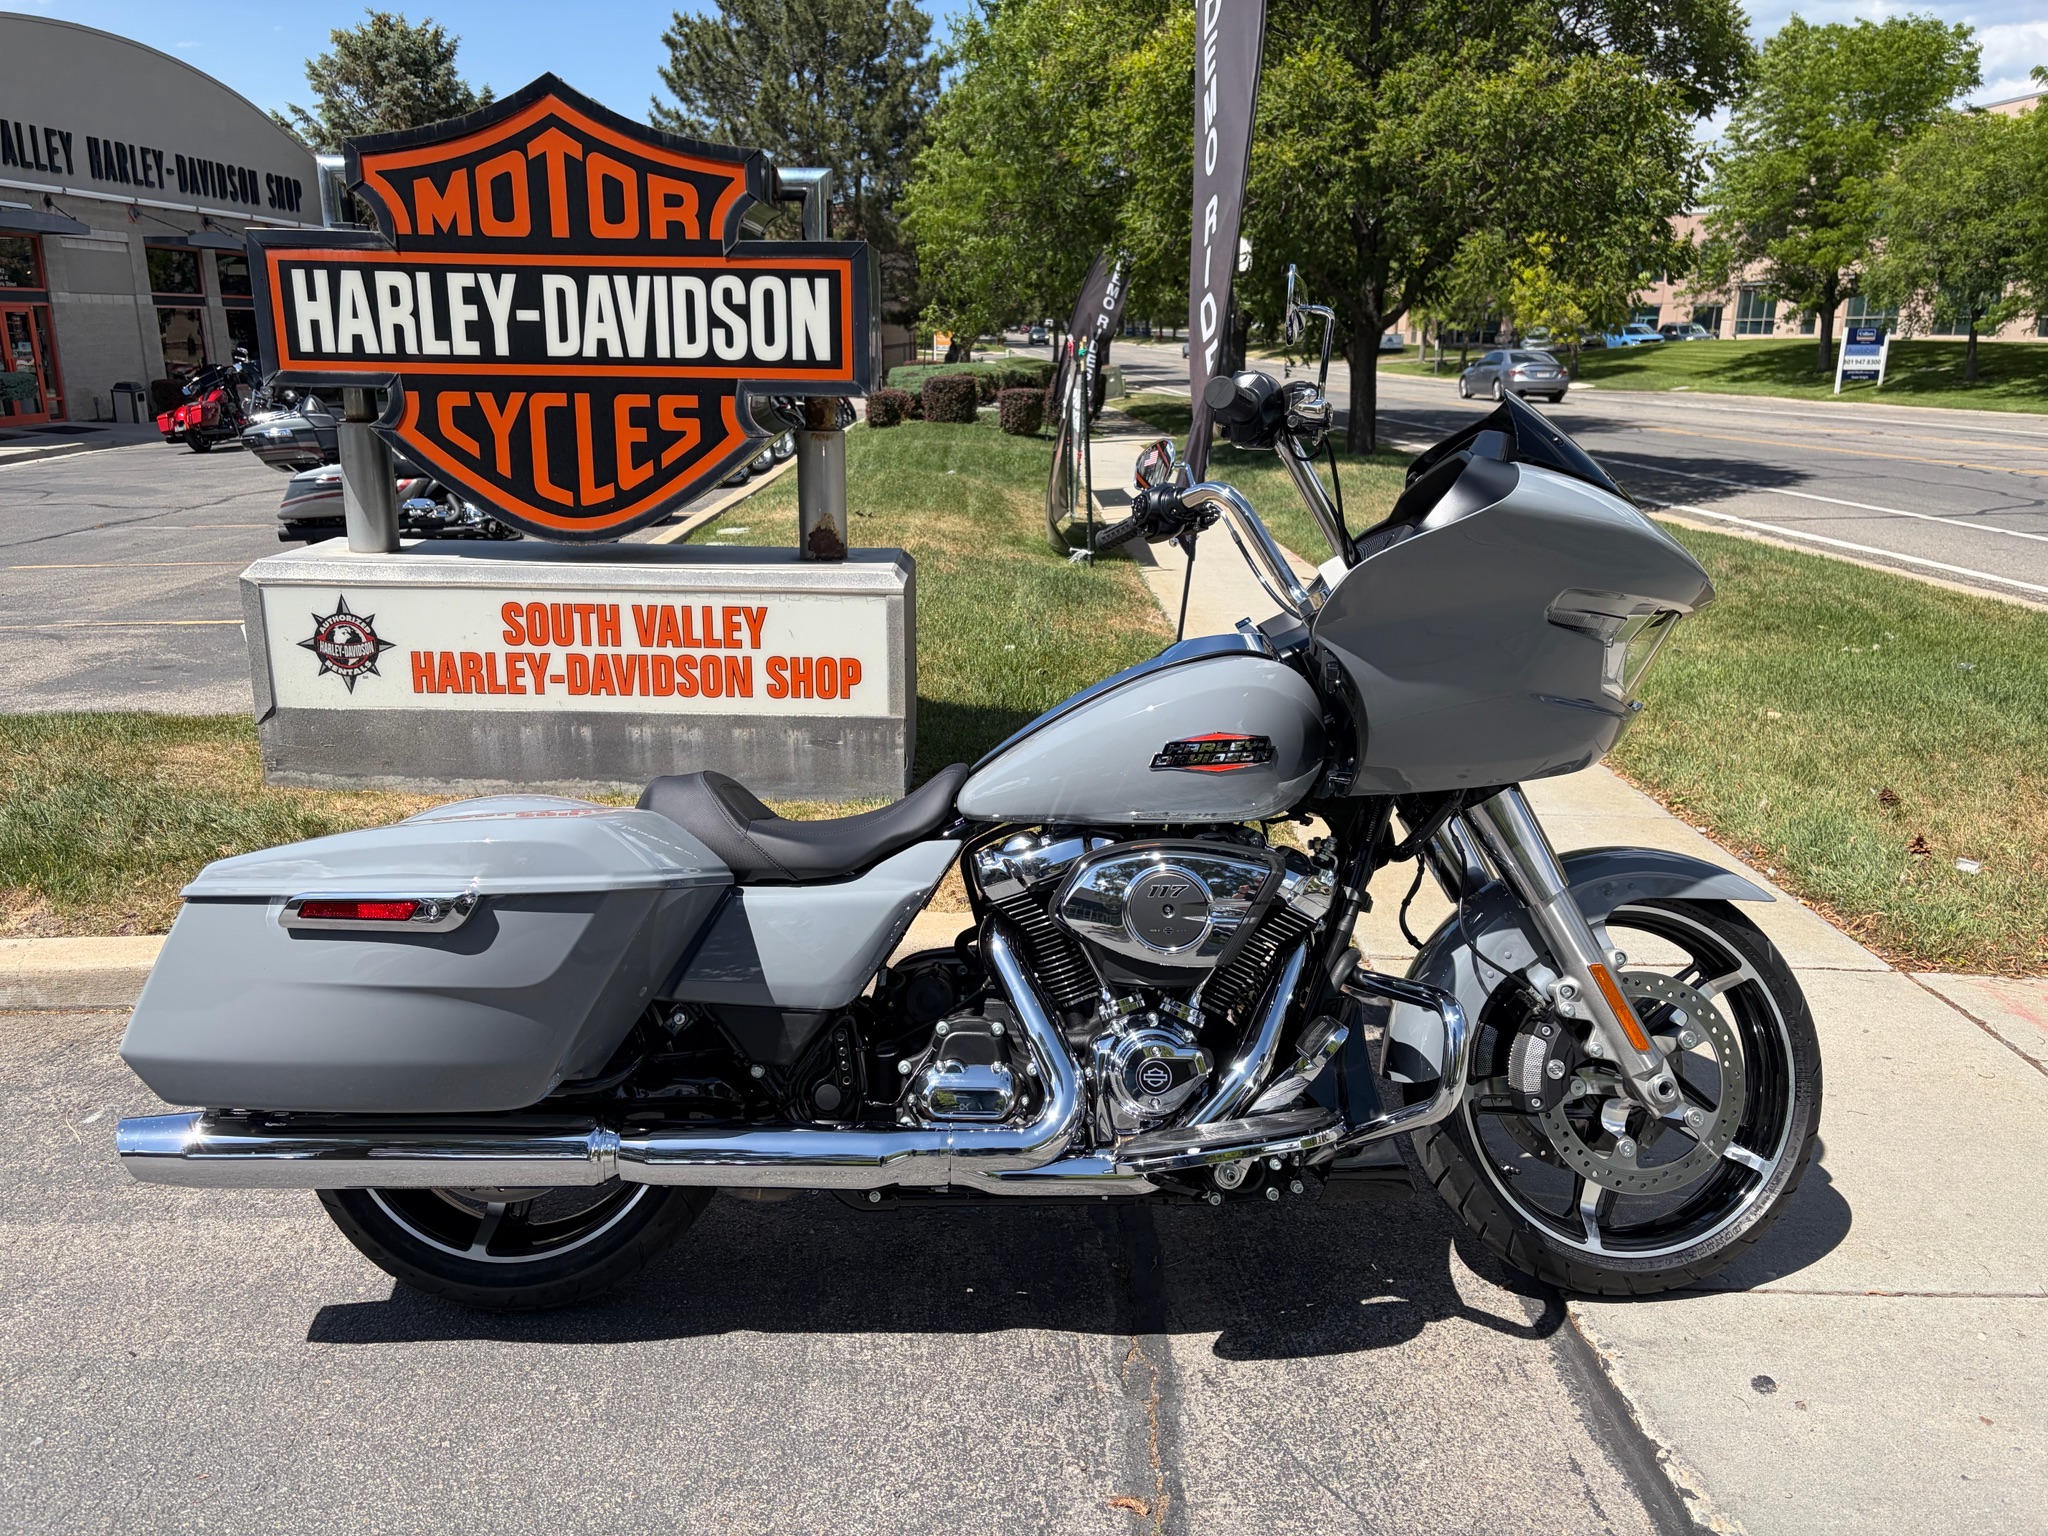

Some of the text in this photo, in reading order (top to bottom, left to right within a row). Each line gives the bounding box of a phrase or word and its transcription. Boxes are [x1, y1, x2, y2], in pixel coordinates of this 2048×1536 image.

[1202, 0, 1222, 176] DEMO
[86, 136, 261, 206] HARLEY-DAVIDSON
[266, 172, 303, 213] SHOP
[412, 126, 700, 241] MOTOR
[291, 268, 832, 362] HARLEY-DAVIDSON
[437, 391, 701, 507] CYCLES
[319, 614, 371, 634] AUTHORIZED
[501, 601, 768, 650] SOUTH VALLEY
[319, 640, 375, 658] HARLEY-DAVIDSON
[324, 660, 372, 676] RENTALS
[410, 650, 863, 700] HARLEY-DAVIDSON SHOP
[1154, 750, 1271, 766] DAVIDSON
[1147, 884, 1190, 898] 117
